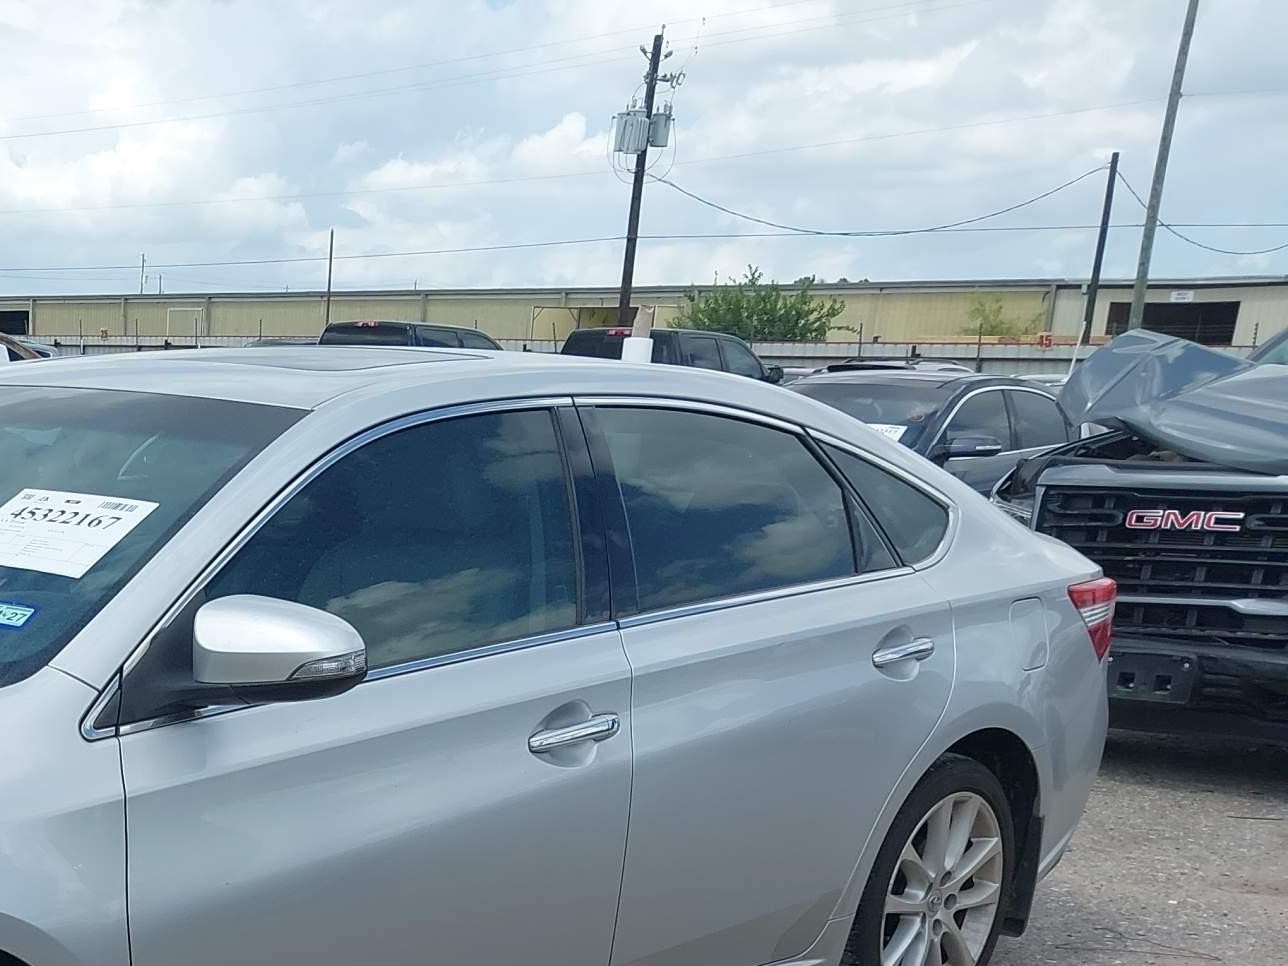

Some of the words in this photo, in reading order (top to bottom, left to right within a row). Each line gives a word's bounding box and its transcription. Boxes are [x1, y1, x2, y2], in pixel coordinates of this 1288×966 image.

[10, 505, 123, 530] 45322167
[1125, 509, 1245, 532] GMC
[6, 611, 28, 622] 27
